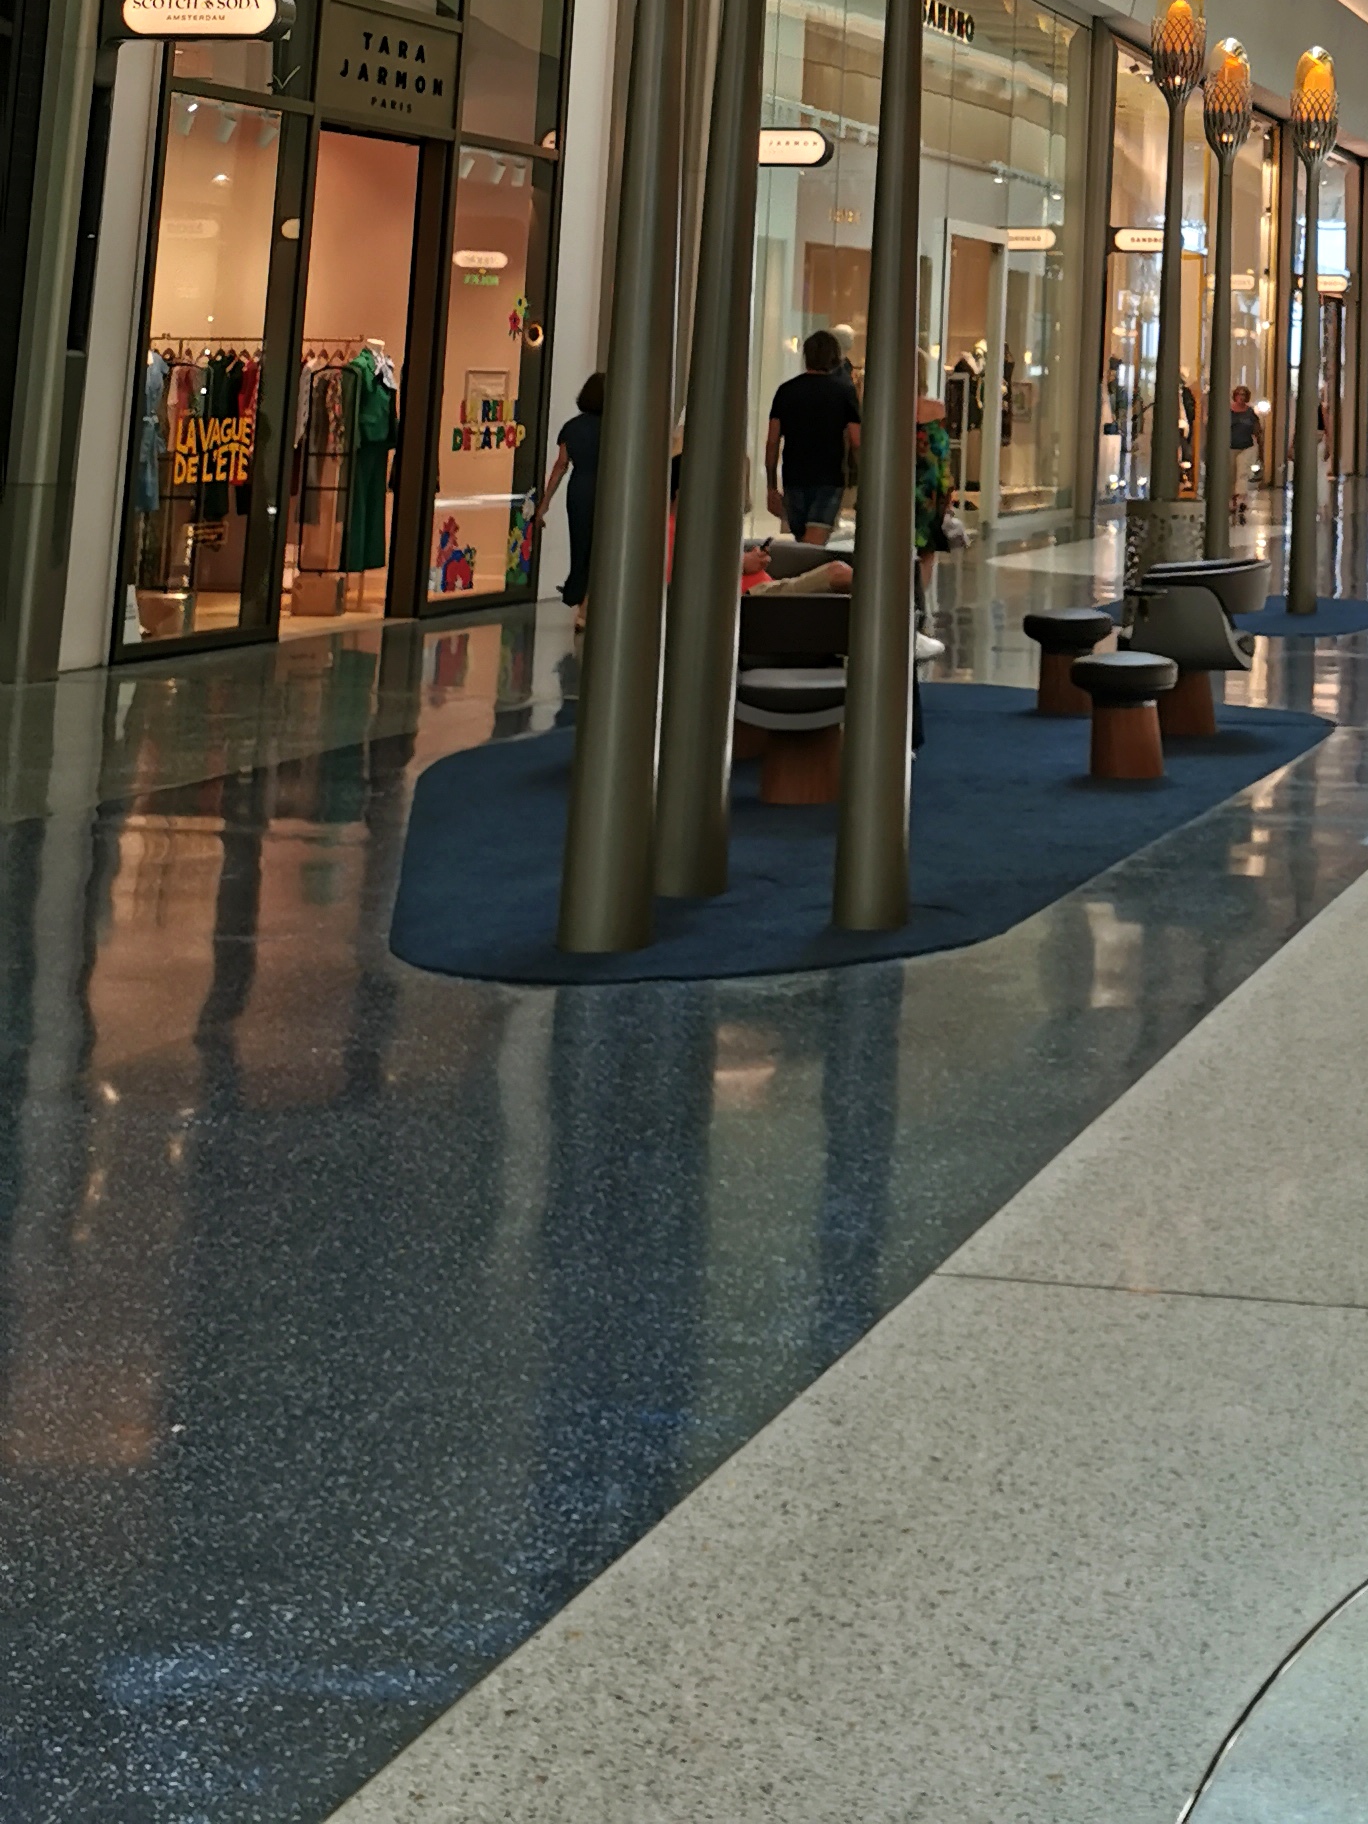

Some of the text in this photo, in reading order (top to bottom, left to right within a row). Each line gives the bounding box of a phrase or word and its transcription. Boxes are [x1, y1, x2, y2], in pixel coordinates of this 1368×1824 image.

[363, 32, 425, 64] TARA
[340, 59, 443, 96] JARMON
[371, 96, 412, 113] PARIS
[176, 416, 254, 454] LA VAGUE
[495, 424, 526, 449] POP
[173, 452, 199, 485] DE
